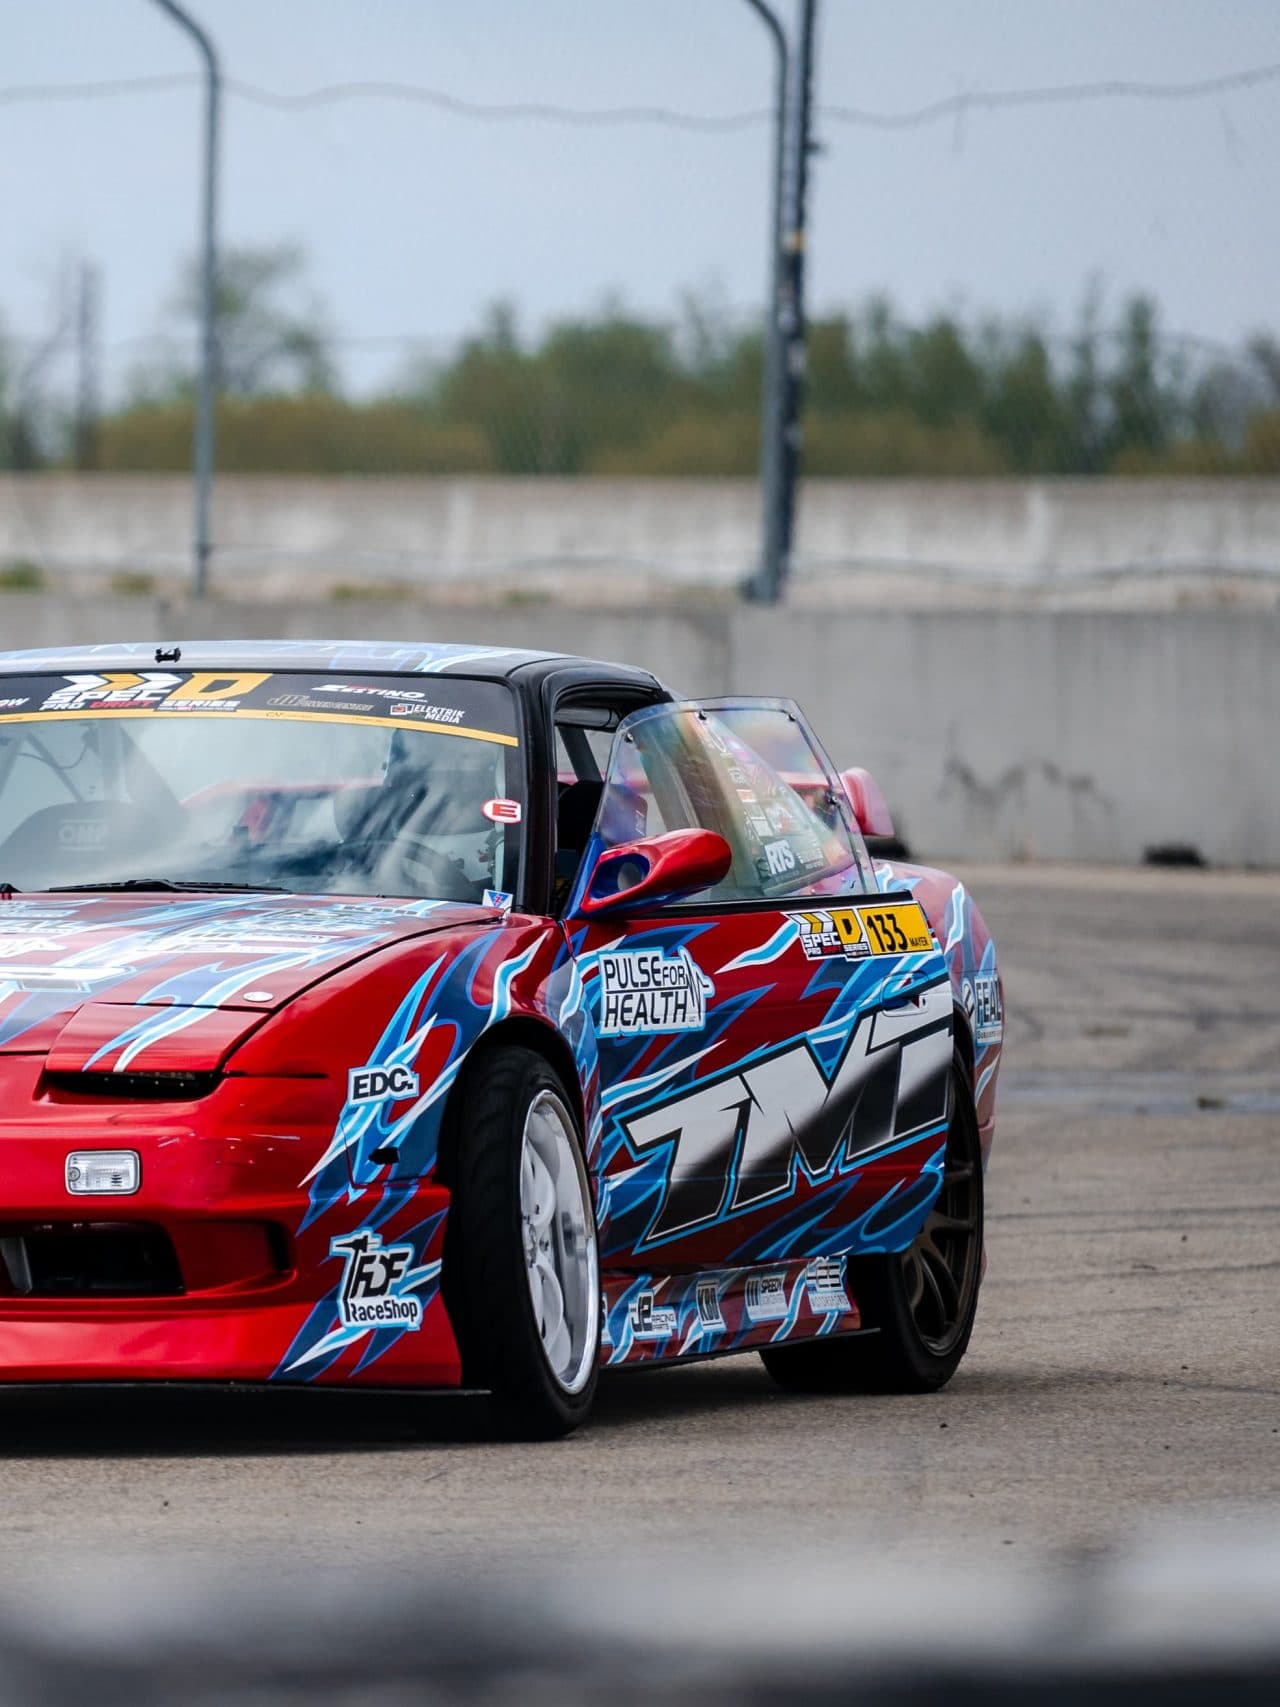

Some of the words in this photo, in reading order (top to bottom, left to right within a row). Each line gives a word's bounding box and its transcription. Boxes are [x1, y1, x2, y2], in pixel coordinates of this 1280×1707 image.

[39, 701, 85, 711] PRO
[89, 700, 155, 709] DRIFT
[413, 704, 465, 719] ELEKTRIK
[424, 711, 461, 724] MEDIA
[801, 932, 841, 948] SPEC
[867, 913, 909, 952] 133
[603, 956, 662, 989] PULSE
[662, 965, 688, 987] FOR
[604, 990, 688, 1028] HEALTH
[976, 980, 1002, 1026] FEAL
[349, 1298, 418, 1323] RaceShop
